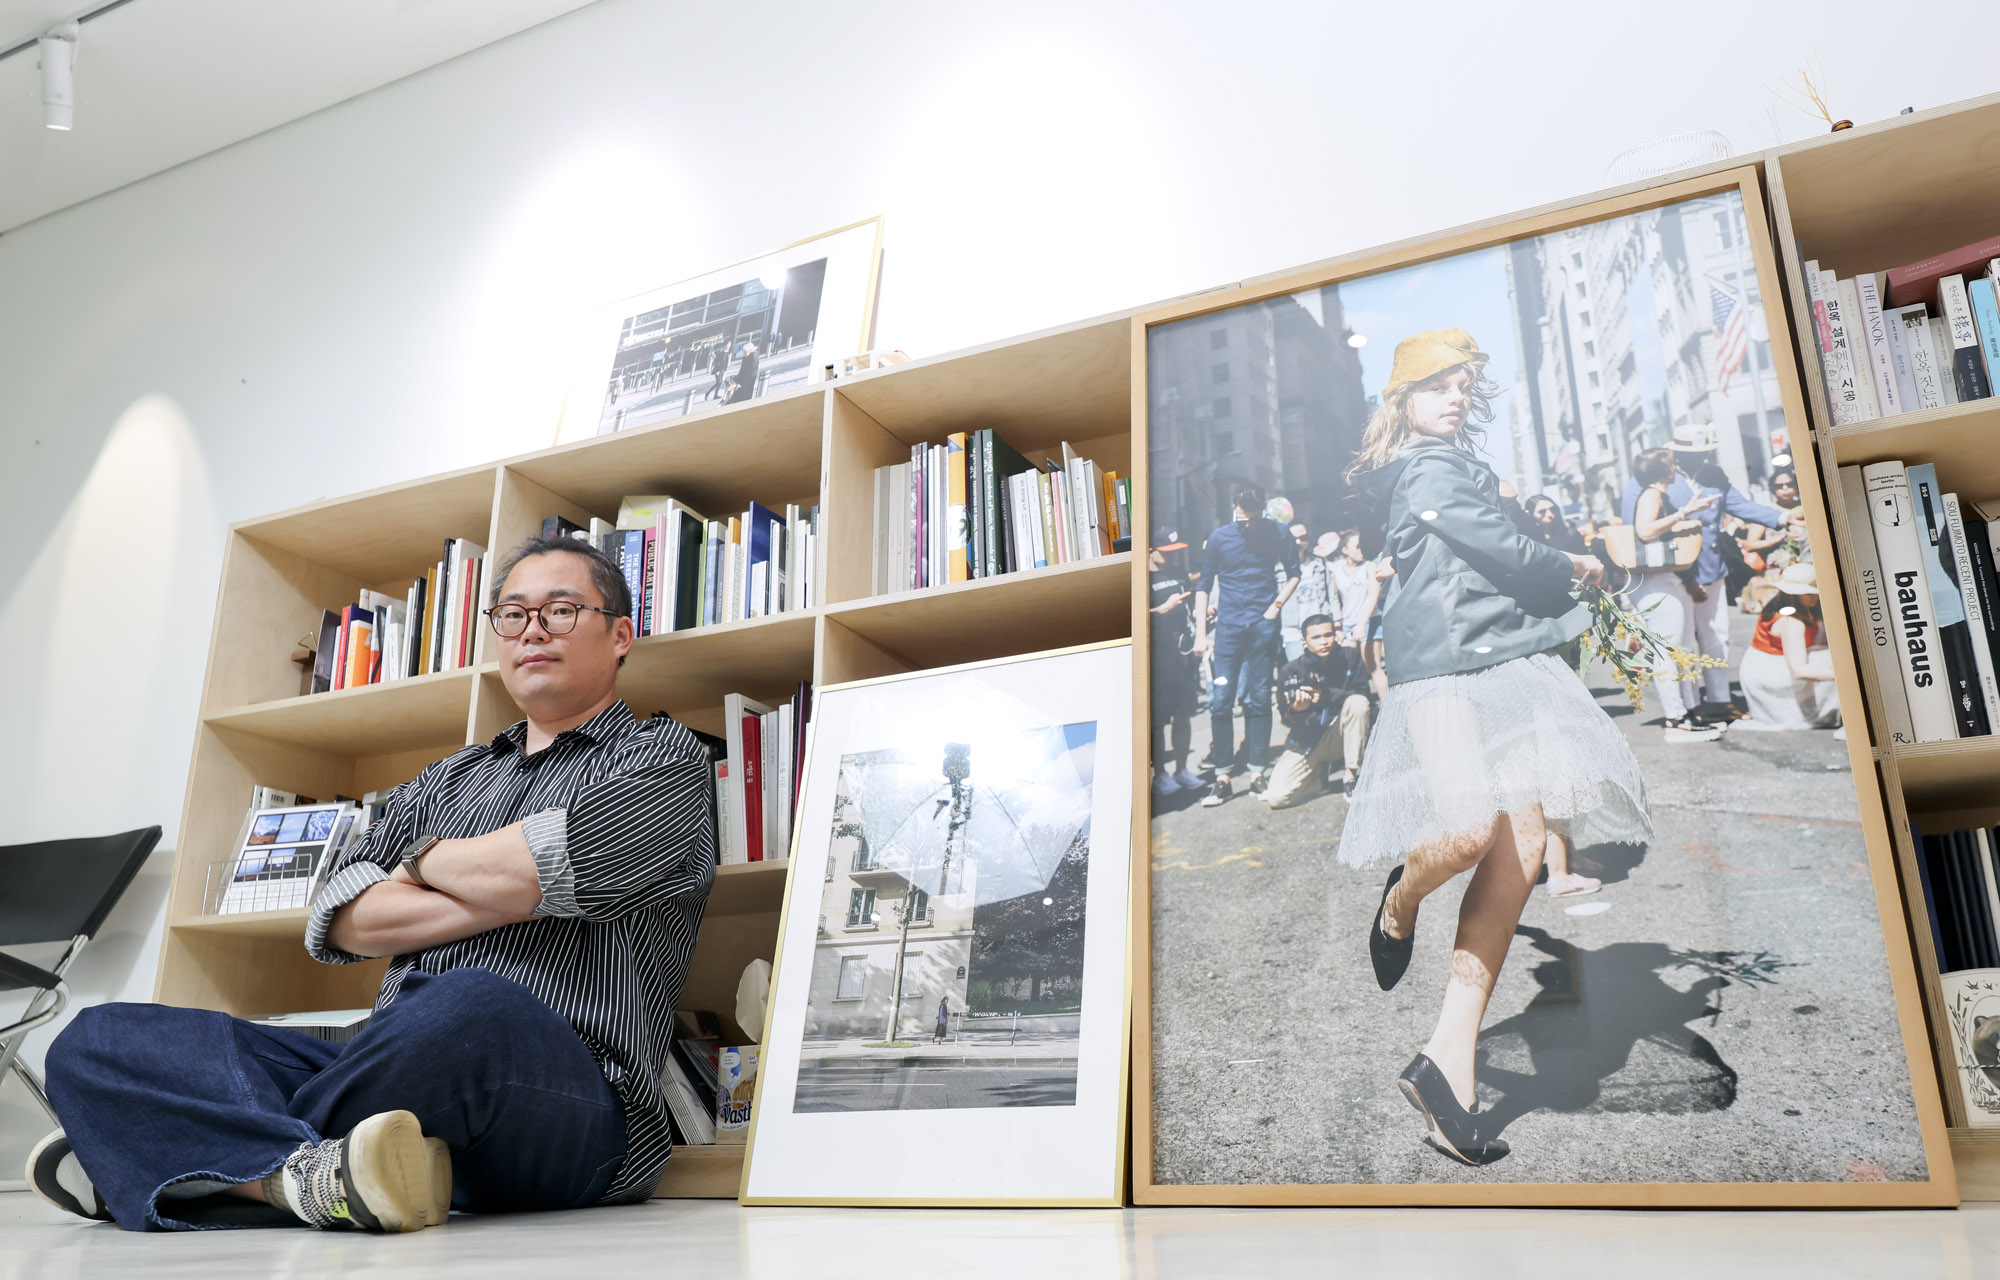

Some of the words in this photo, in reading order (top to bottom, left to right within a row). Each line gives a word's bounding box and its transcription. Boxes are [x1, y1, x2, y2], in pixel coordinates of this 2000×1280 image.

[1863, 283, 1876, 304] THE
[1826, 300, 1840, 322] 한옥
[1868, 306, 1885, 346] HANOK
[1832, 326, 1850, 373] 설계에서
[1914, 350, 1931, 373] 한옥
[1842, 378, 1860, 422] 시공까지
[1920, 375, 1936, 400] 짓는
[1947, 501, 1956, 518] SOU
[1951, 519, 1966, 555] FUJIMOTO
[647, 541, 655, 569] PUBLIC
[1958, 556, 1973, 586] RECENT
[1862, 570, 1884, 622] STUDIO
[1874, 626, 1888, 647] KO
[1965, 588, 1980, 621] PROJECT
[1894, 570, 1933, 688] bauhaus
